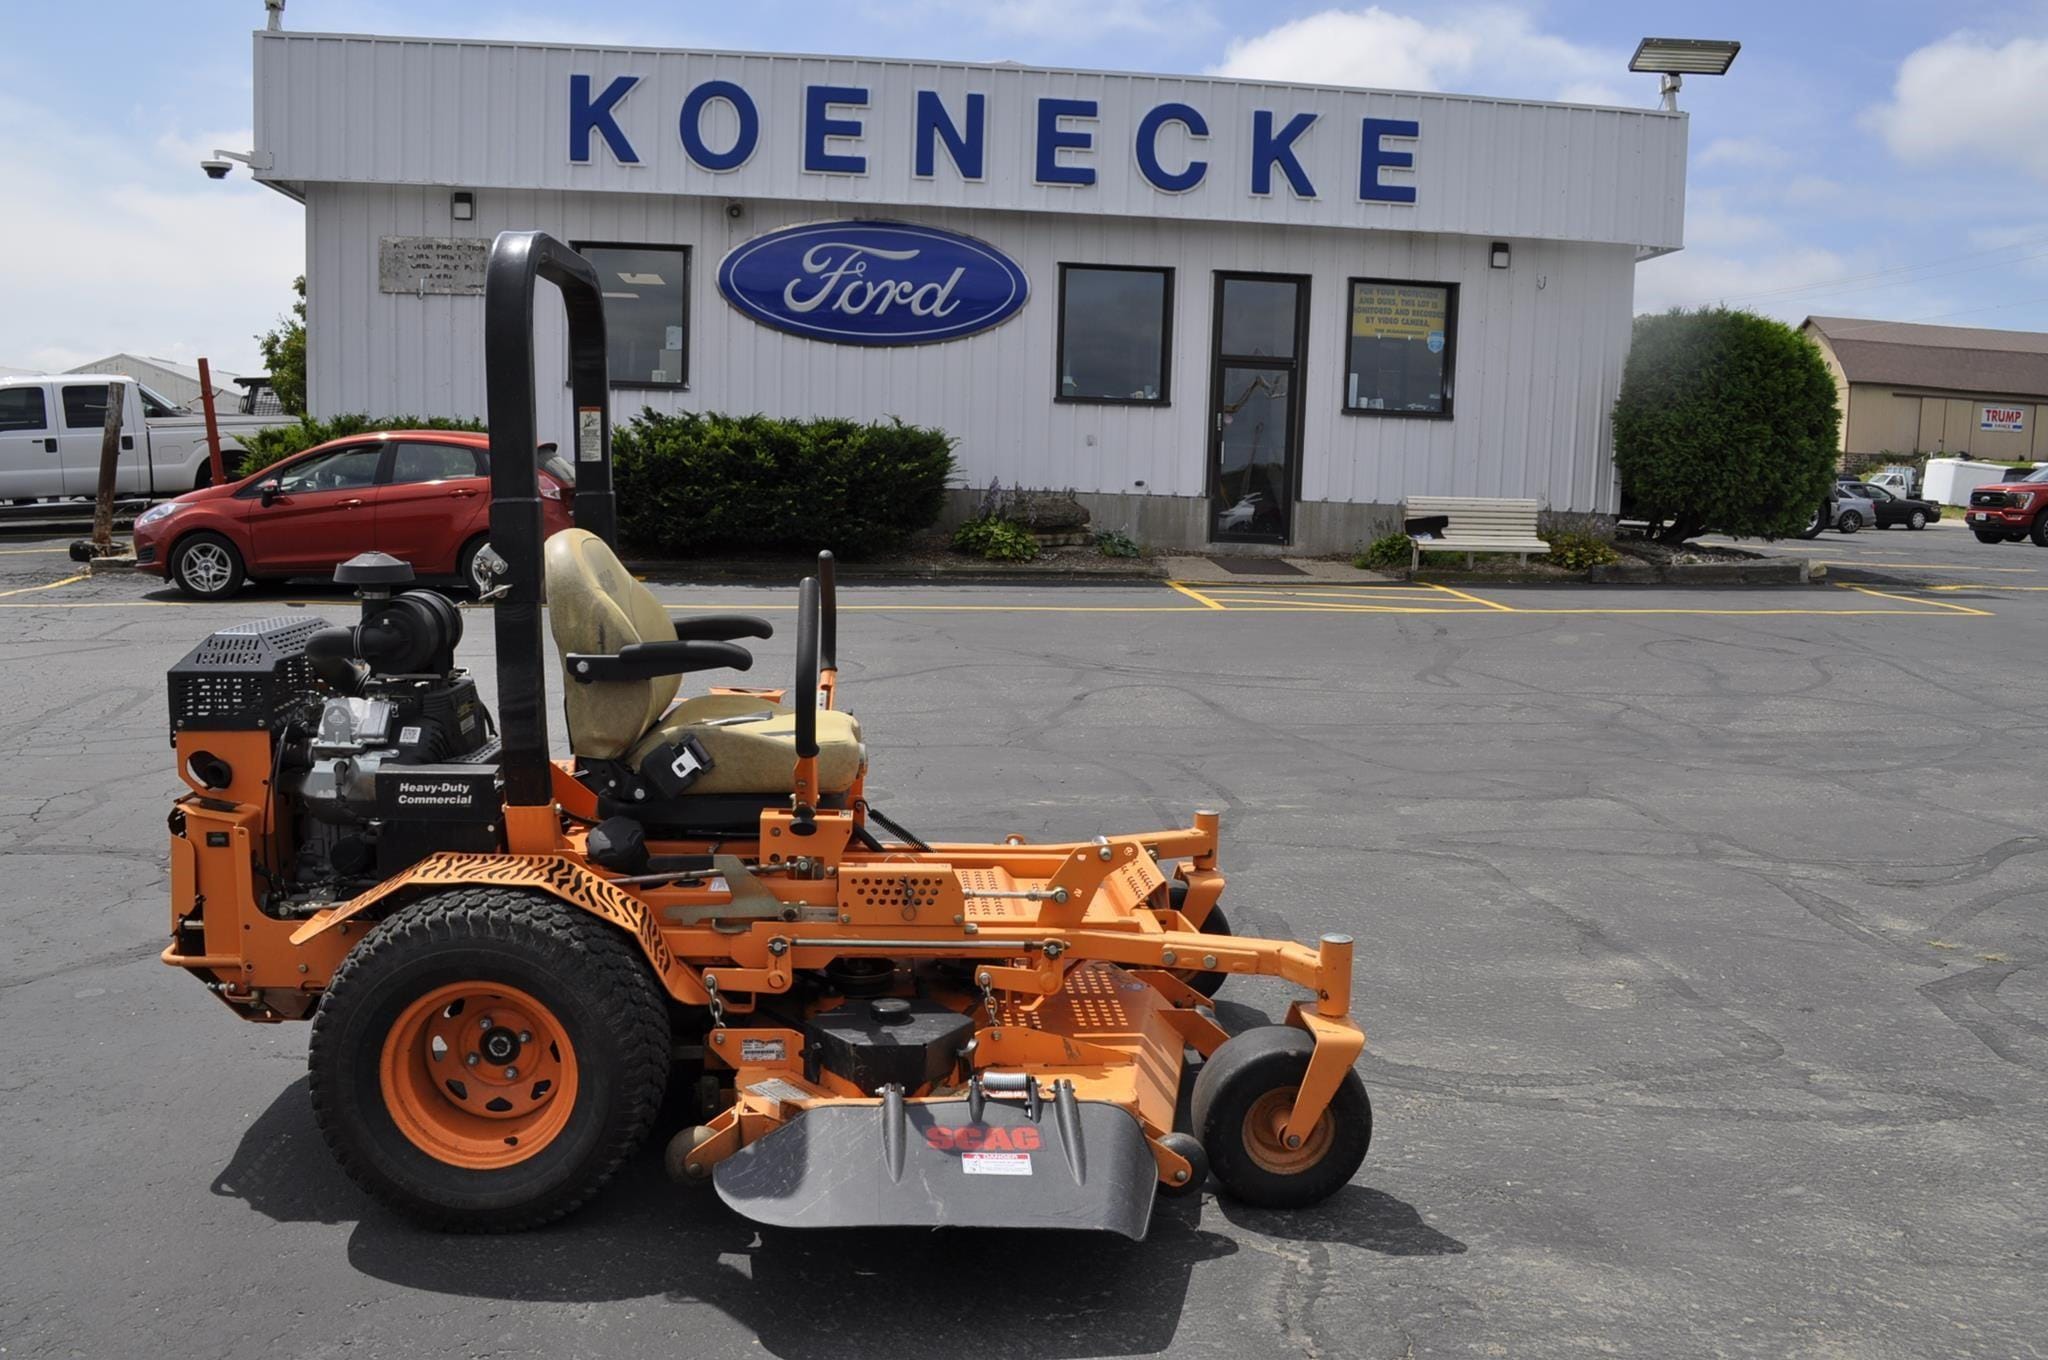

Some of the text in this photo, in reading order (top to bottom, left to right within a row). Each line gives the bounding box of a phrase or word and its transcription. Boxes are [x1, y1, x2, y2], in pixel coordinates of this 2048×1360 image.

[568, 74, 1420, 203] KOENECKE
[783, 242, 966, 318] Ford
[1359, 297, 1375, 305] AND
[1395, 307, 1410, 316] AND
[1985, 409, 2022, 423] TRUMP
[399, 782, 470, 794] Heavy-Duty
[398, 794, 473, 804] Commercial
[926, 1125, 1041, 1151] SCAG
